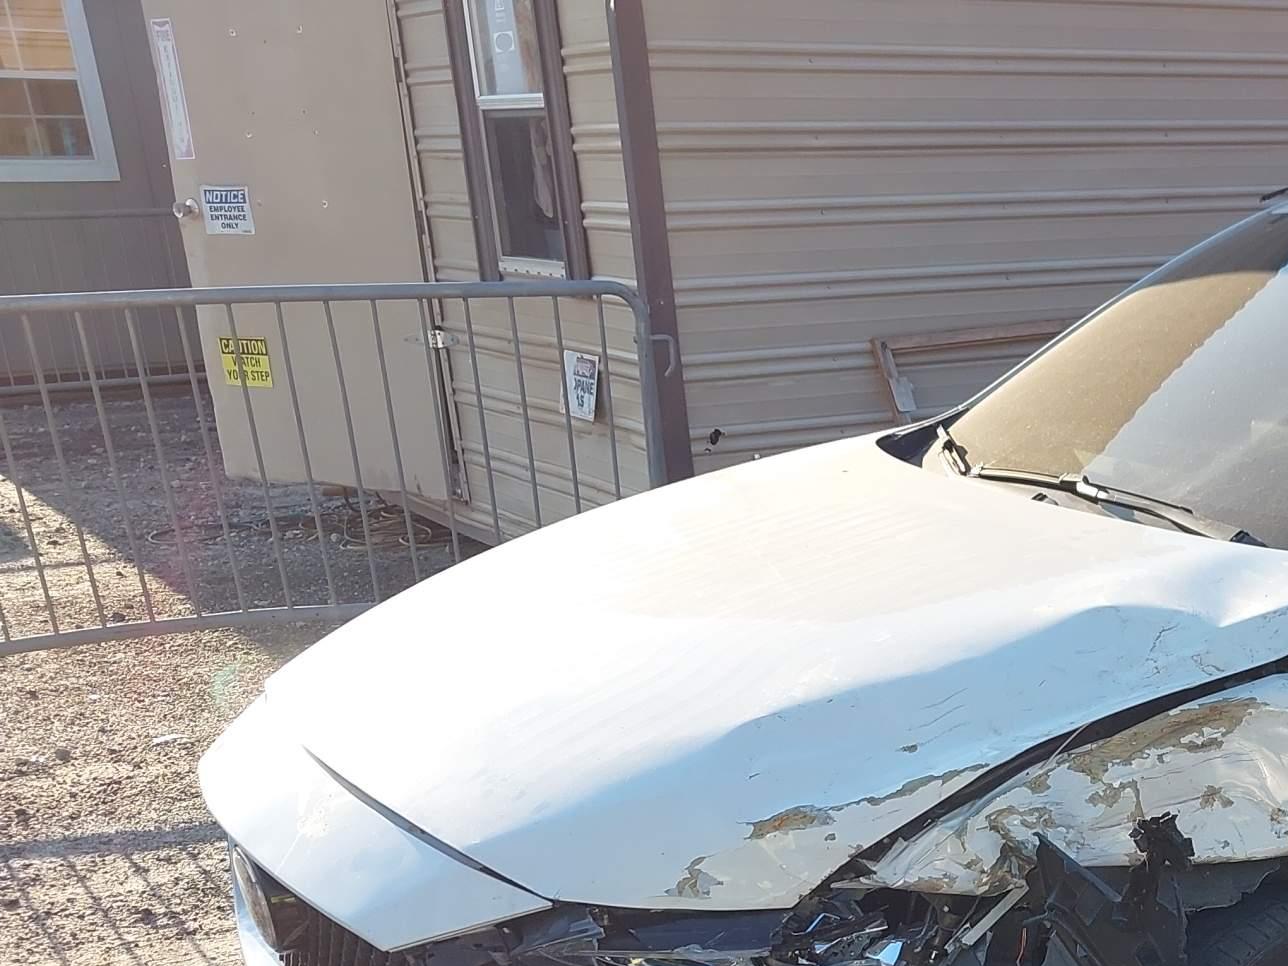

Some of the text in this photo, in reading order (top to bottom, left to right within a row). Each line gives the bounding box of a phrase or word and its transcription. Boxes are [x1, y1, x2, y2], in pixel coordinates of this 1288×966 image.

[206, 191, 245, 203] NOTICE
[209, 205, 246, 213] EMPLOYEE
[221, 339, 267, 354] CATION
[227, 369, 270, 382] YOR STEP
